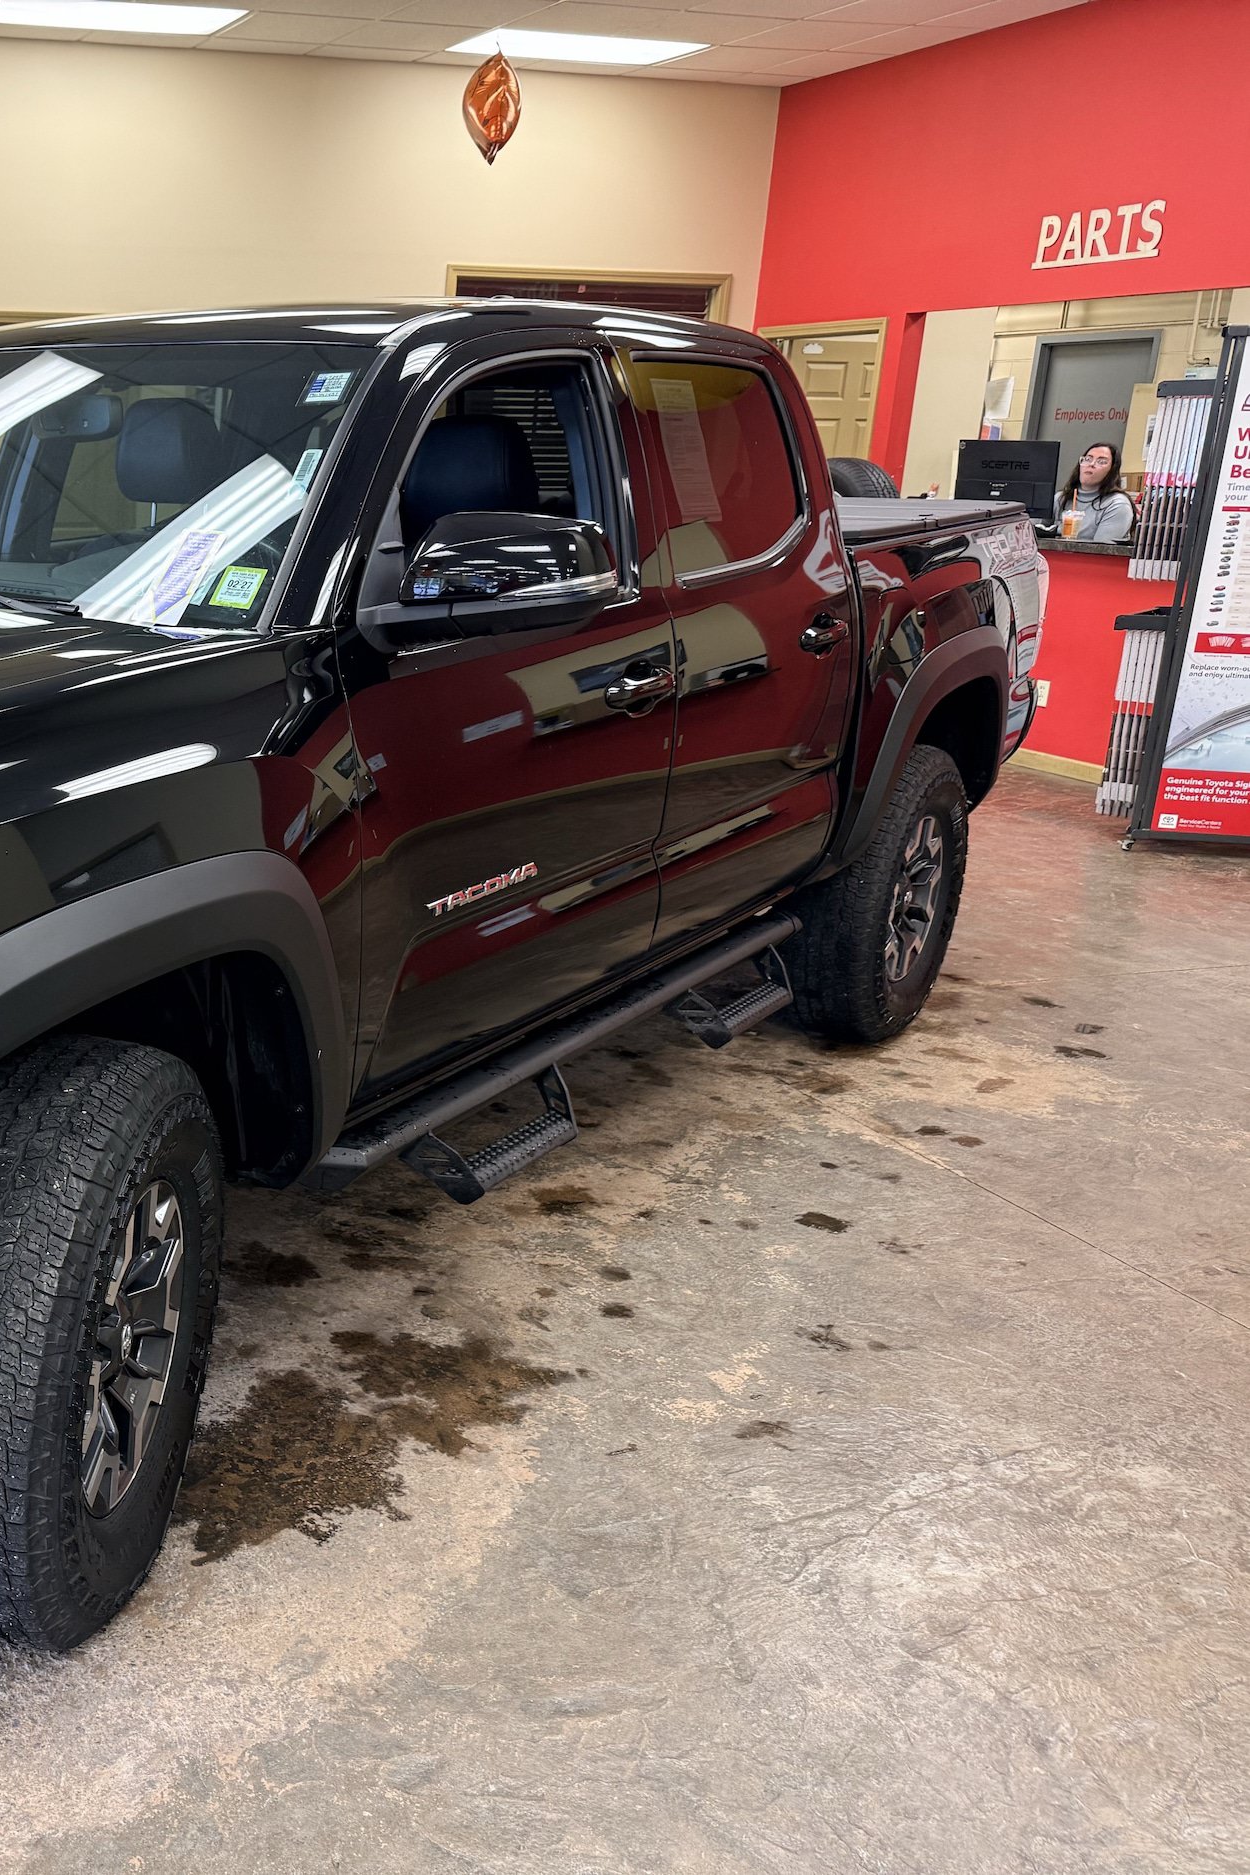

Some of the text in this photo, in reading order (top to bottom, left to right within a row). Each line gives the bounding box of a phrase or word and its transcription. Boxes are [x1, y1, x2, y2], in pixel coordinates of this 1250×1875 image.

[1034, 199, 1167, 266] PARTS
[1054, 407, 1129, 424] Employees Only
[981, 459, 1031, 470] SCEPTRE
[1224, 493, 1248, 502] your
[1167, 777, 1203, 785] Genuine
[1205, 779, 1234, 789] Toyota
[1165, 786, 1214, 794] engineered
[1216, 787, 1229, 795] for
[1212, 796, 1248, 804] function
[424, 862, 538, 917] TACOMA
